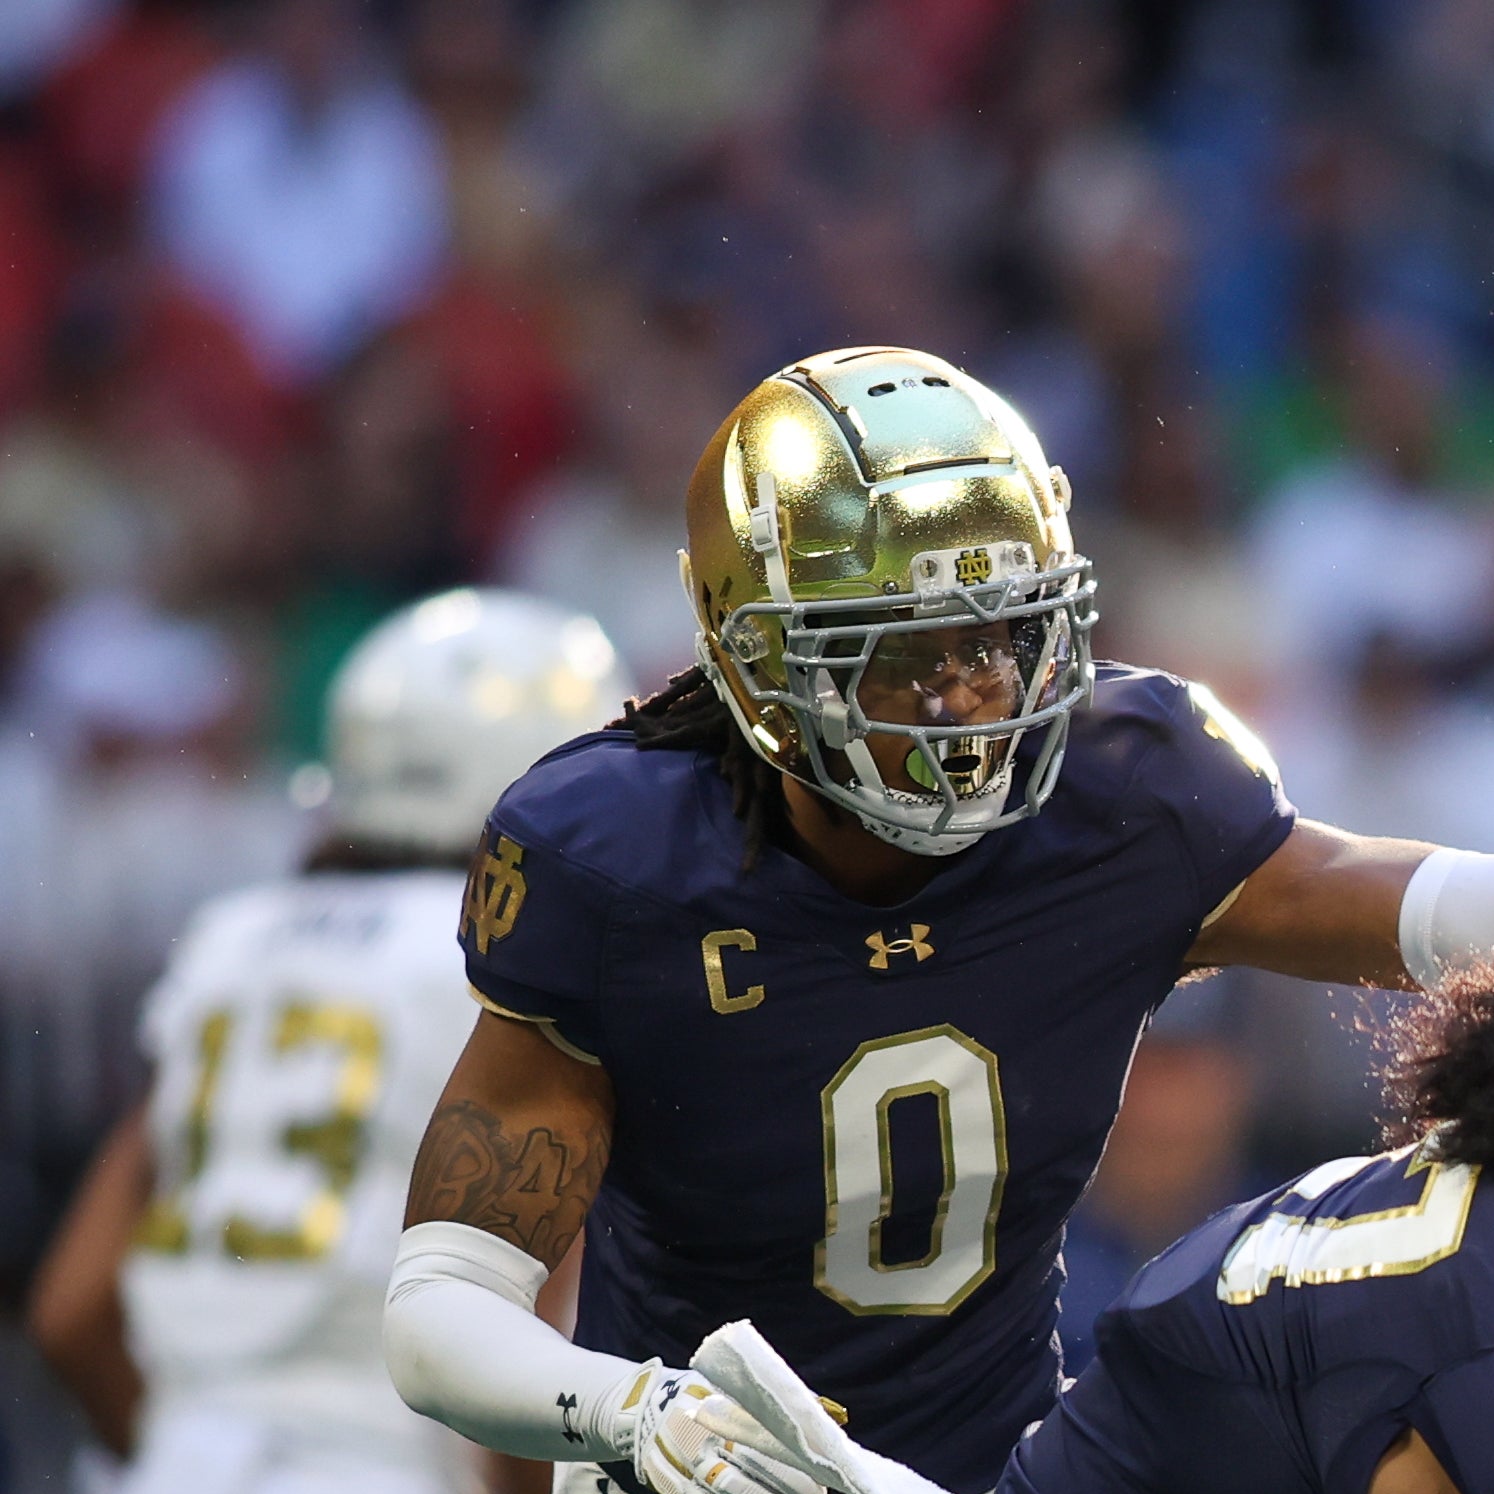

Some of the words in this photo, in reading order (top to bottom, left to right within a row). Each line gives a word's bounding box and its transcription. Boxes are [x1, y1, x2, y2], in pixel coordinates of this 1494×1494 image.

[701, 927, 765, 1016] C
[130, 1000, 384, 1262] 13
[813, 1022, 1009, 1318] 0
